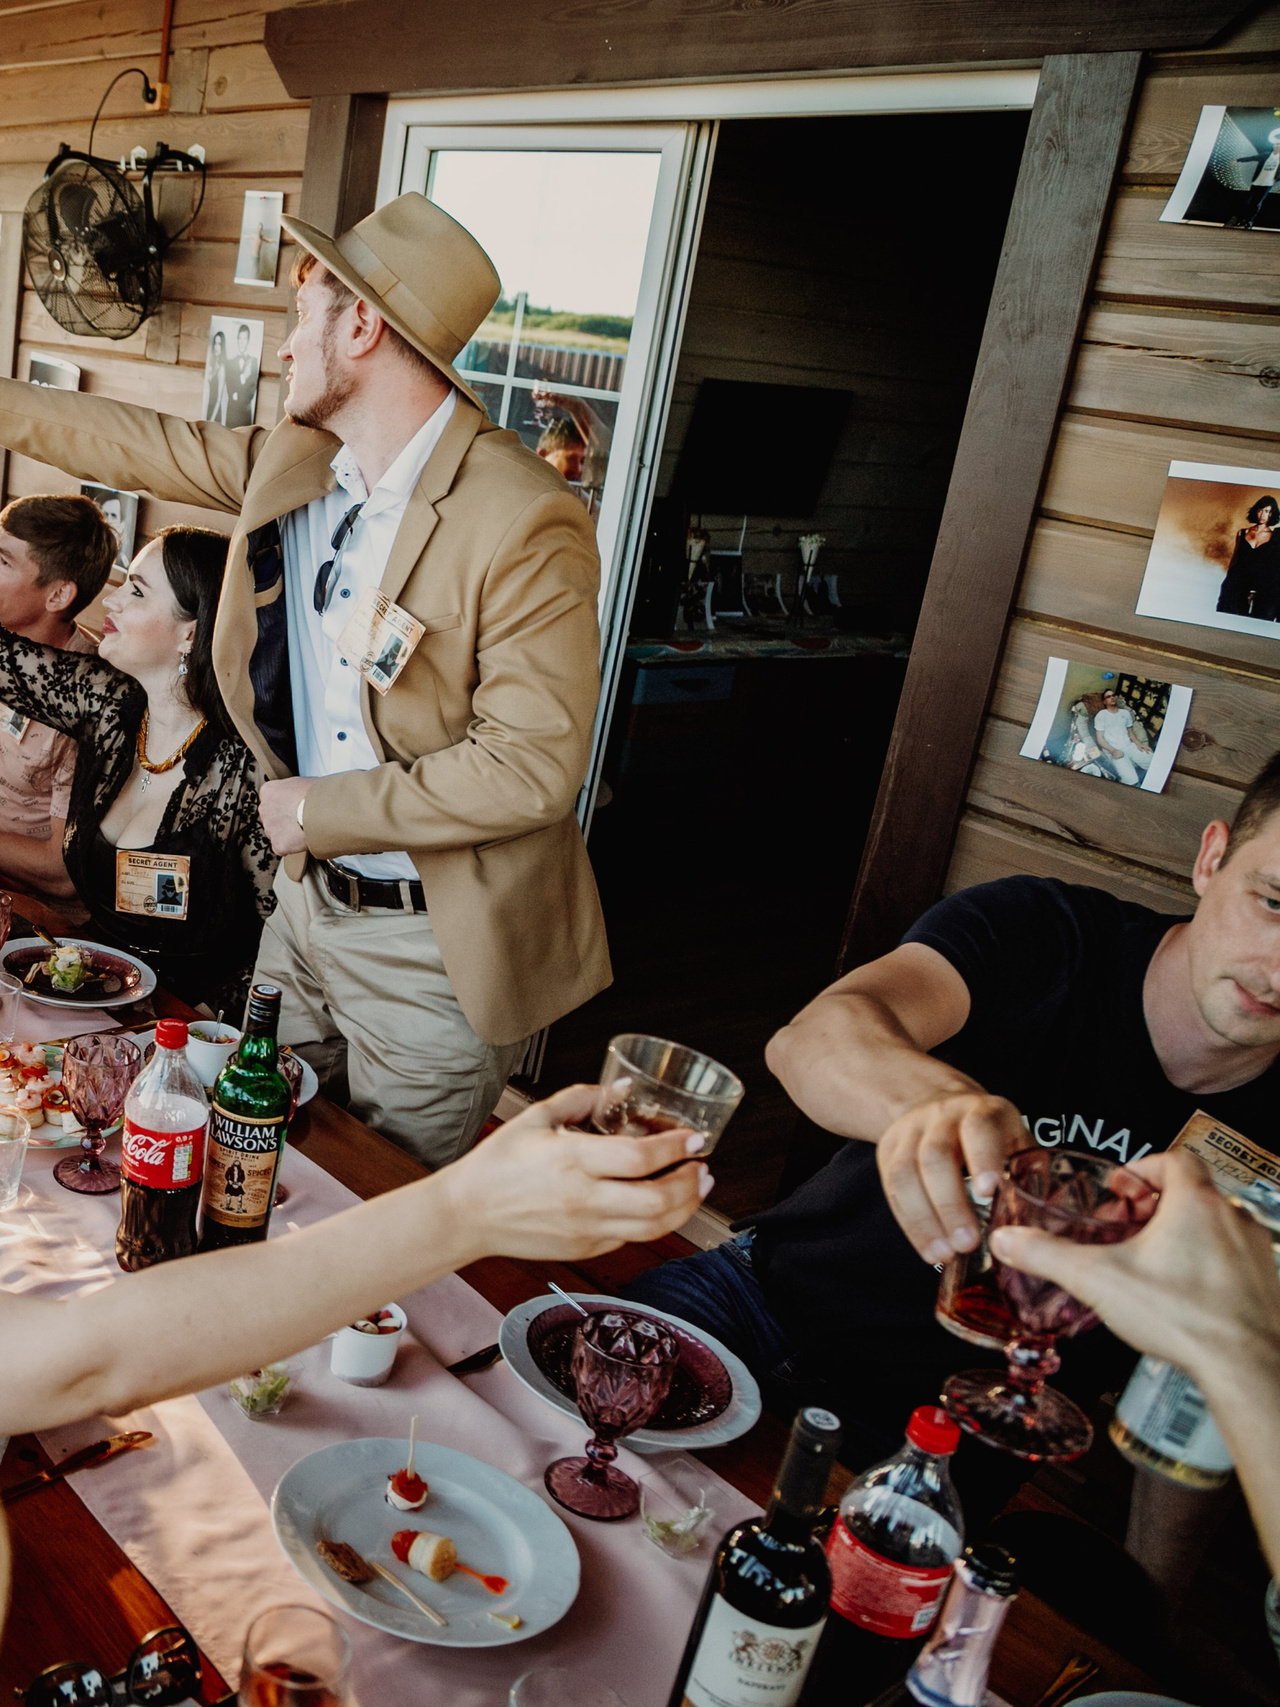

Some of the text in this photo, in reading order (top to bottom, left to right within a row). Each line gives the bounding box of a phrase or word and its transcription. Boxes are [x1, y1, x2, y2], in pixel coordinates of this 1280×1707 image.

[128, 858, 178, 869] SECRET AGENT
[214, 1112, 276, 1139] WILLIAM
[210, 1123, 278, 1152] LAWSON'S
[1207, 1131, 1258, 1164] SECRET
[219, 1146, 260, 1160] SPIRIT DRINK
[247, 1167, 273, 1177] SPICED
